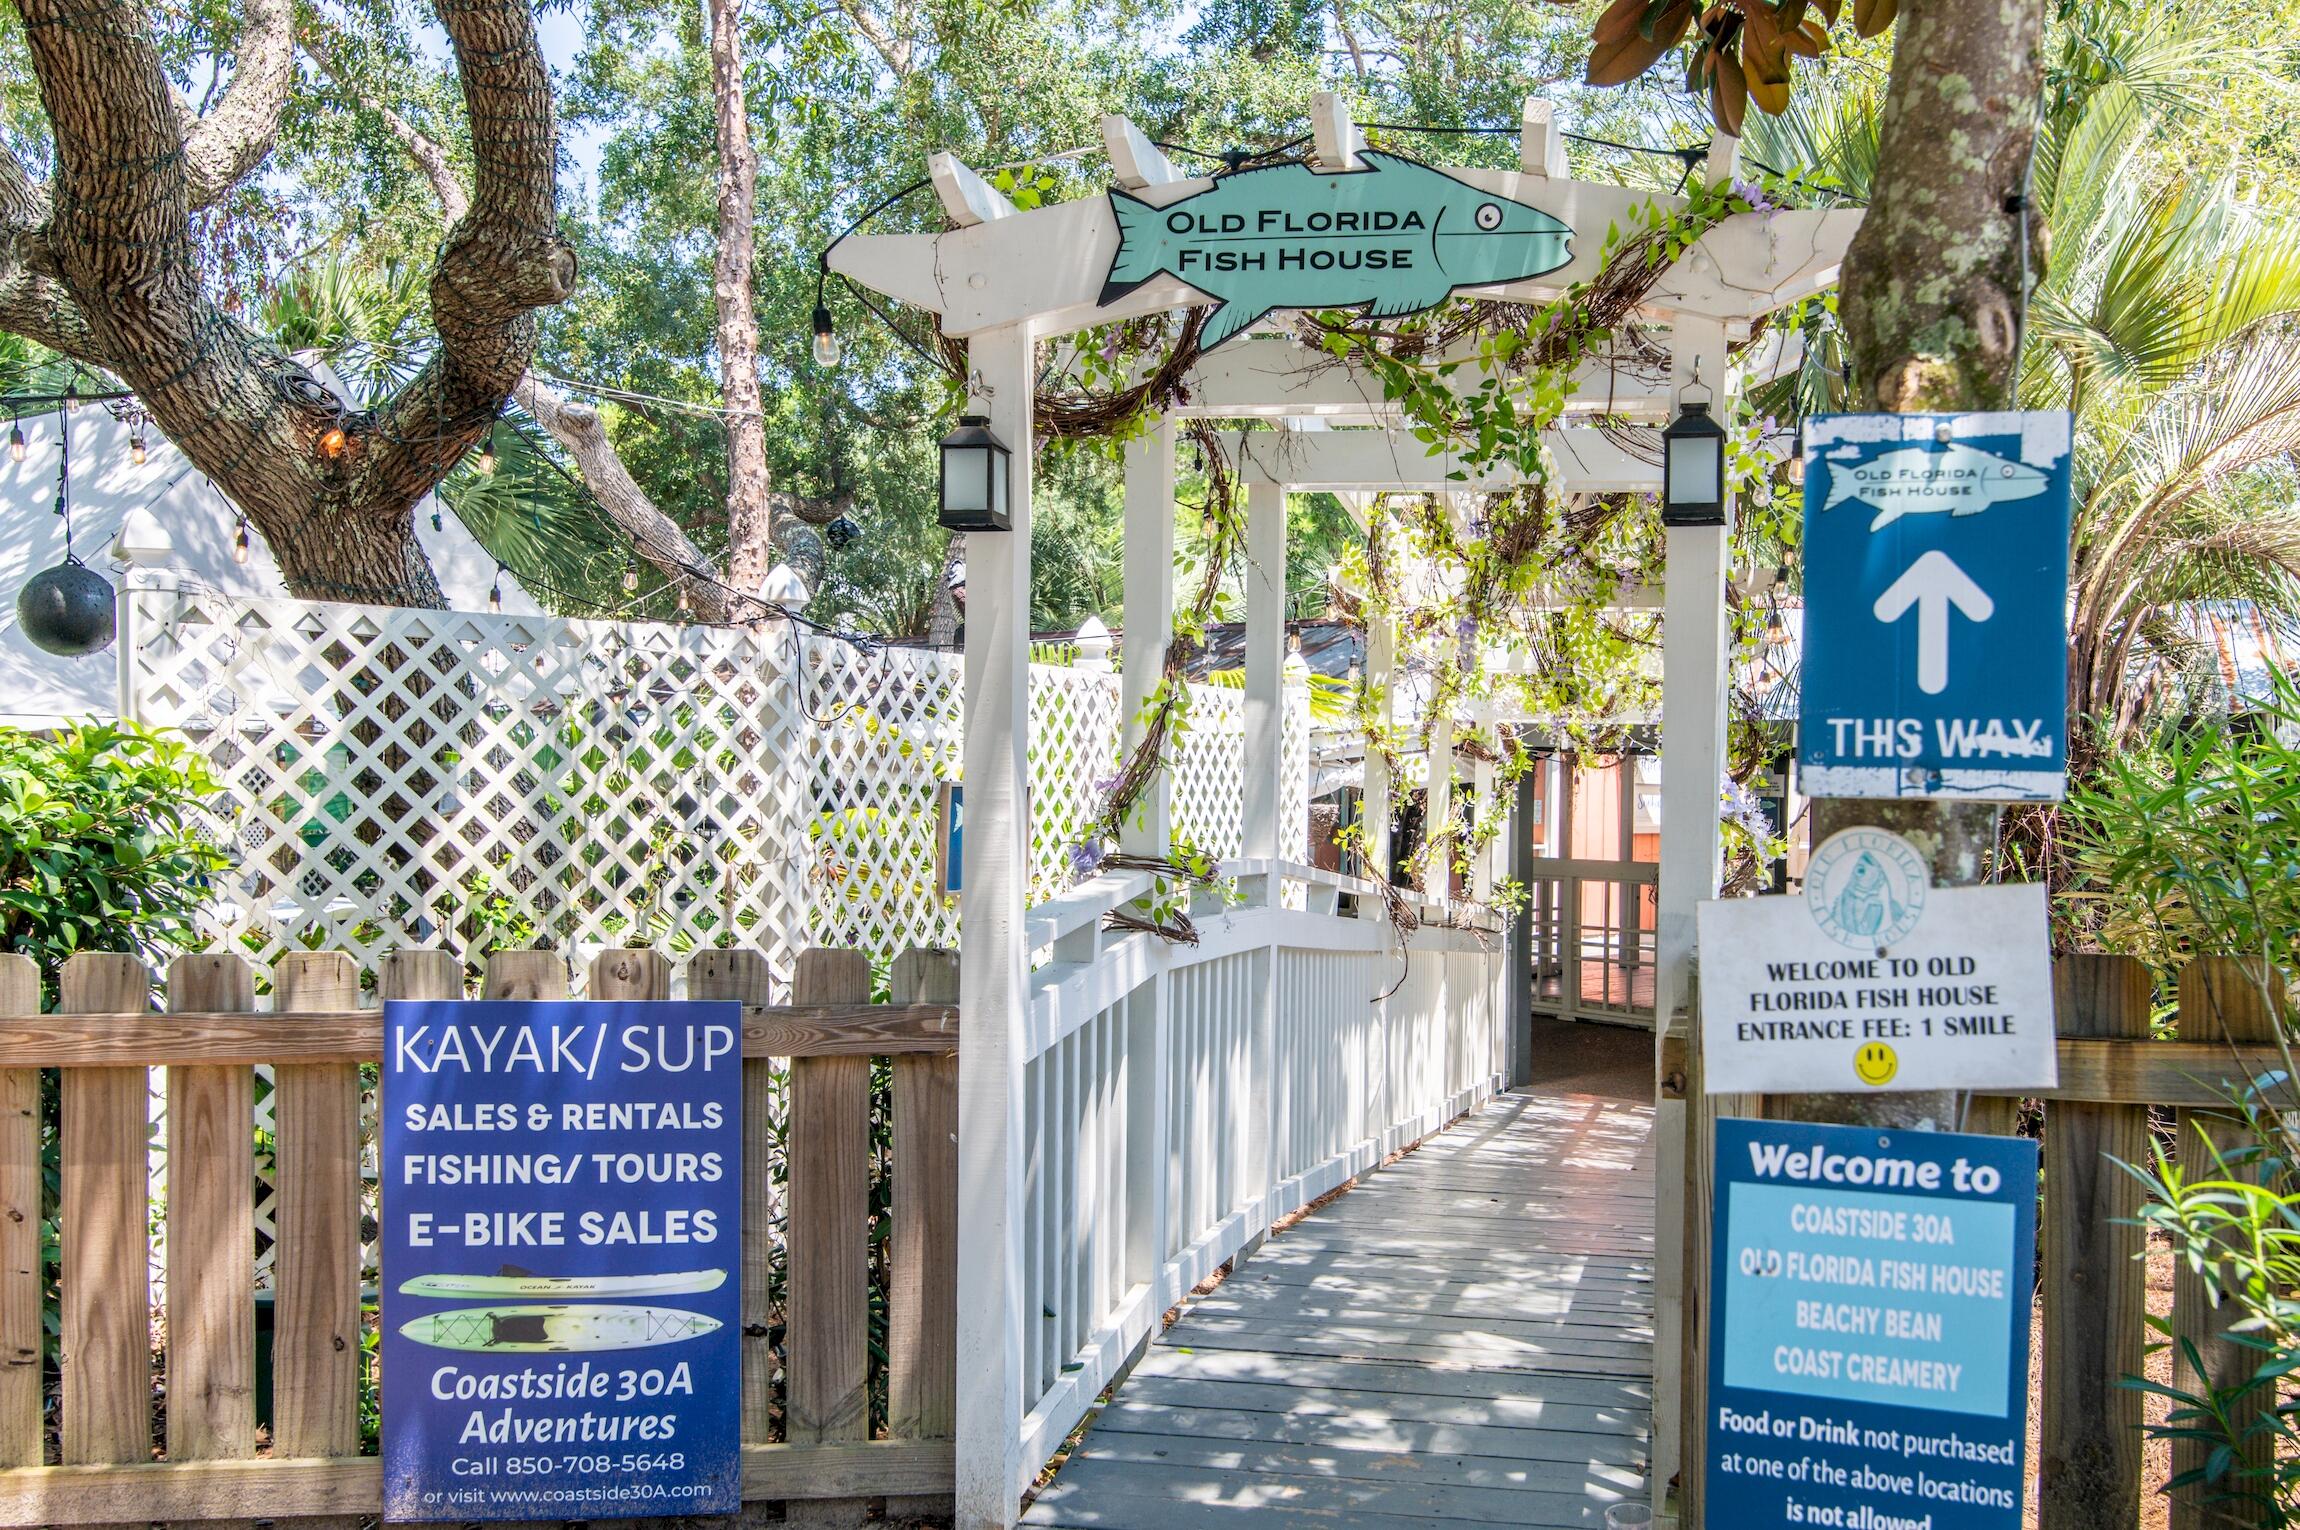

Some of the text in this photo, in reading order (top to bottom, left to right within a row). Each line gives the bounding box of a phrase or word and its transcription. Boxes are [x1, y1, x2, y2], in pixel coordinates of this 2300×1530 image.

[1166, 209, 1426, 235] OLD FLORIDA
[1178, 247, 1413, 272] FISH HOUSE
[1853, 467, 1977, 481] OLD FLORIDA
[1859, 485, 1972, 498] FISH HOUSE
[1826, 718, 2044, 759] THIS WAY
[1767, 956, 1976, 982] WELCOME TO OLD
[1749, 986, 1999, 1012] FLORIDA FISH HOUSE
[1737, 1016, 2016, 1041] ENTRANCE FEE: 1 SMILE
[395, 1022, 734, 1081] KAYAK/ SUP
[405, 1101, 724, 1132] SALES & RENTALS
[404, 1152, 723, 1185] FISHING/ TOURS
[1748, 1140, 2001, 1195] Welcome to
[408, 1209, 718, 1247] E-BIKE SALES
[1790, 1203, 1954, 1245] COASTSIDE 30A
[1740, 1247, 2004, 1299] OLD FLORIDA FISH HOUSE
[1796, 1300, 1942, 1342] BEACHY BEAN
[430, 1361, 694, 1402] Coastside 30A
[1773, 1345, 1962, 1392] COAST CREAMERY
[459, 1408, 677, 1445] Adventures
[1719, 1407, 2015, 1466] Food or Drink not purchased
[451, 1453, 685, 1477] Call 850-708-5648
[1721, 1451, 2014, 1509] at one of the above locations
[424, 1482, 712, 1504] or visit www.coastside30A.com
[1786, 1496, 1932, 1530] is not allowed
